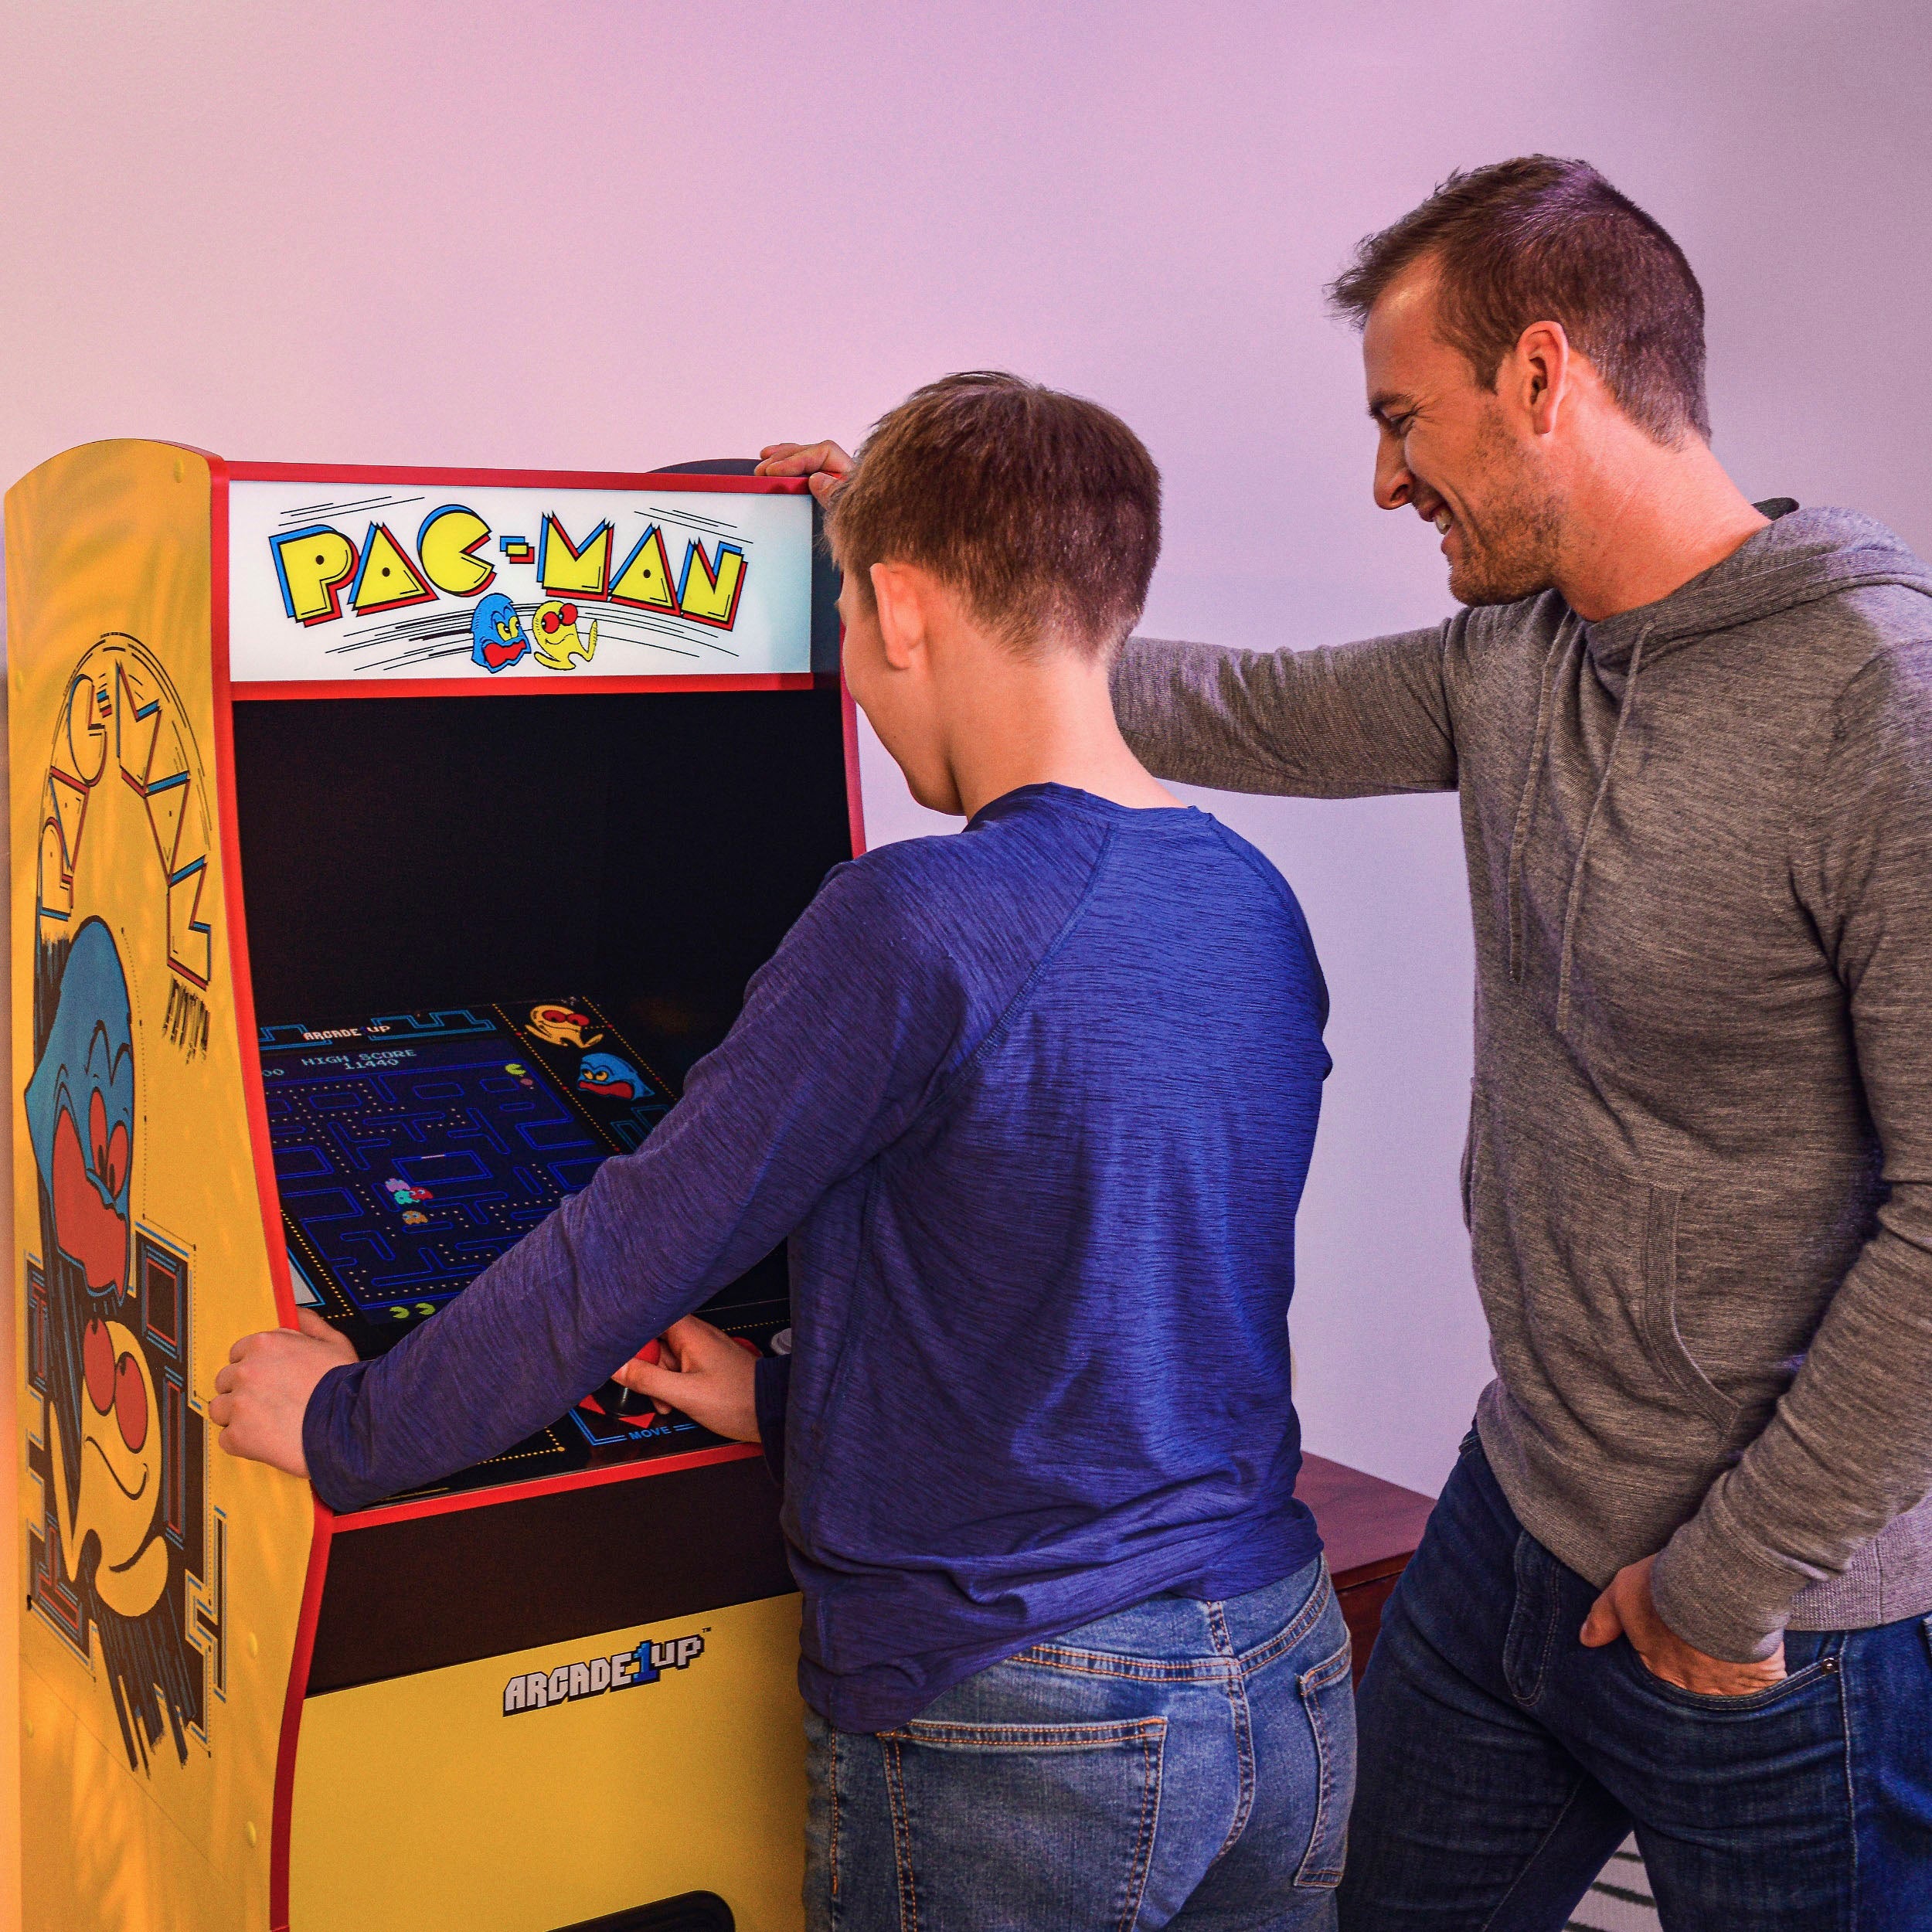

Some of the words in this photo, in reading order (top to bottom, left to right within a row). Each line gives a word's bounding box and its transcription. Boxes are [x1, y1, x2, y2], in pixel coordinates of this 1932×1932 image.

[268, 503, 748, 631] PAC-MAN
[301, 1055, 349, 1066] HIGH
[359, 1049, 417, 1061] SCORE
[345, 1058, 400, 1070] 11440
[628, 1426, 672, 1440] MOVE
[502, 1634, 705, 1717] ARCADE1UP
